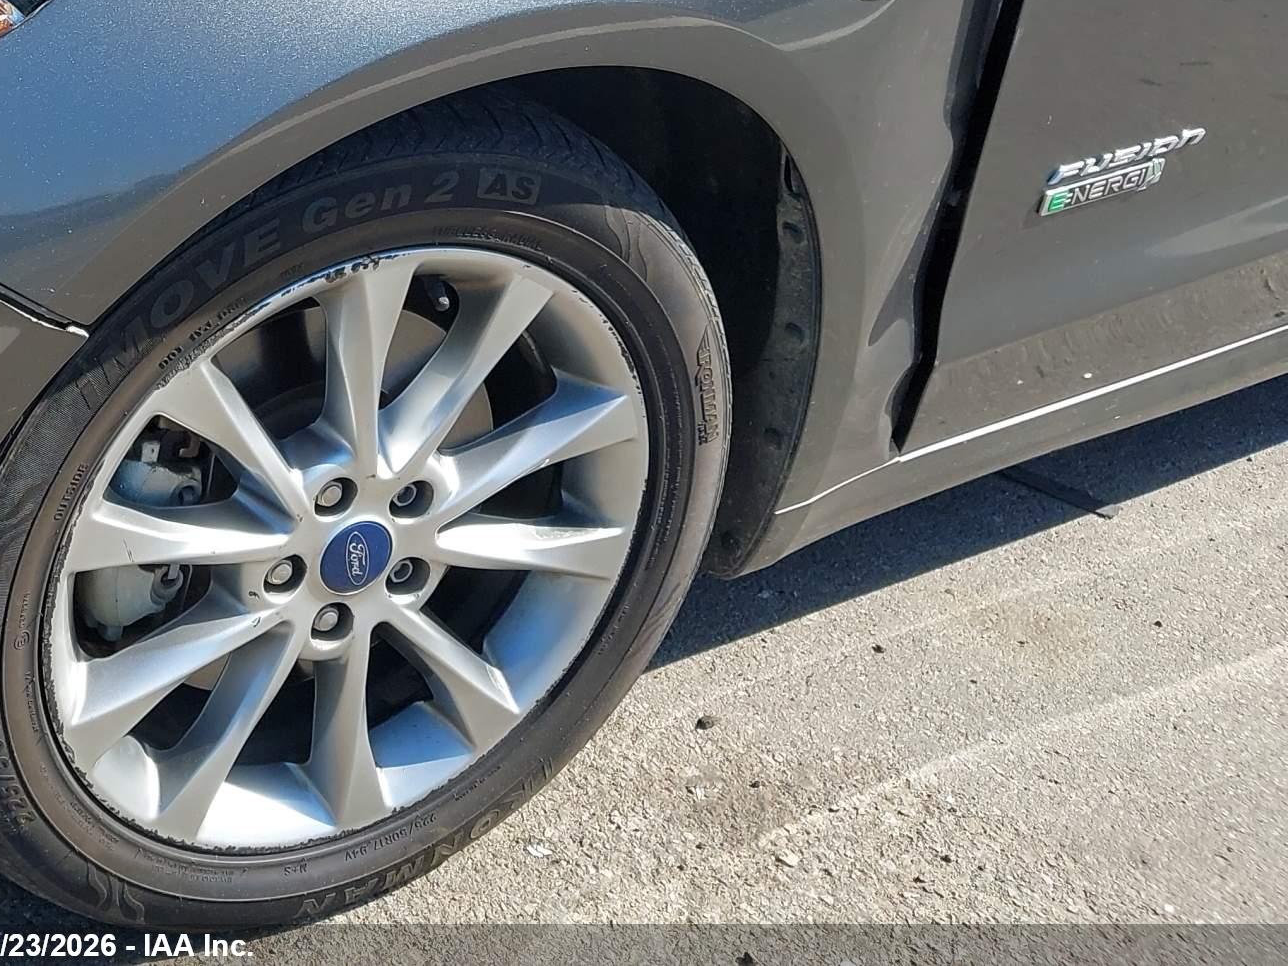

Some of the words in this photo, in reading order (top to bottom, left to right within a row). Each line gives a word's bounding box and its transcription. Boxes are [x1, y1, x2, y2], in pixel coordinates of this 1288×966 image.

[302, 177, 411, 232] Gen
[424, 171, 461, 203] 2
[483, 171, 537, 203] AS
[1048, 167, 1147, 212] ENERGI
[53, 463, 90, 522] OUTSIDE
[349, 541, 366, 577] Ford
[292, 753, 555, 920] IRONMAN
[373, 812, 438, 852] 225/50R17
